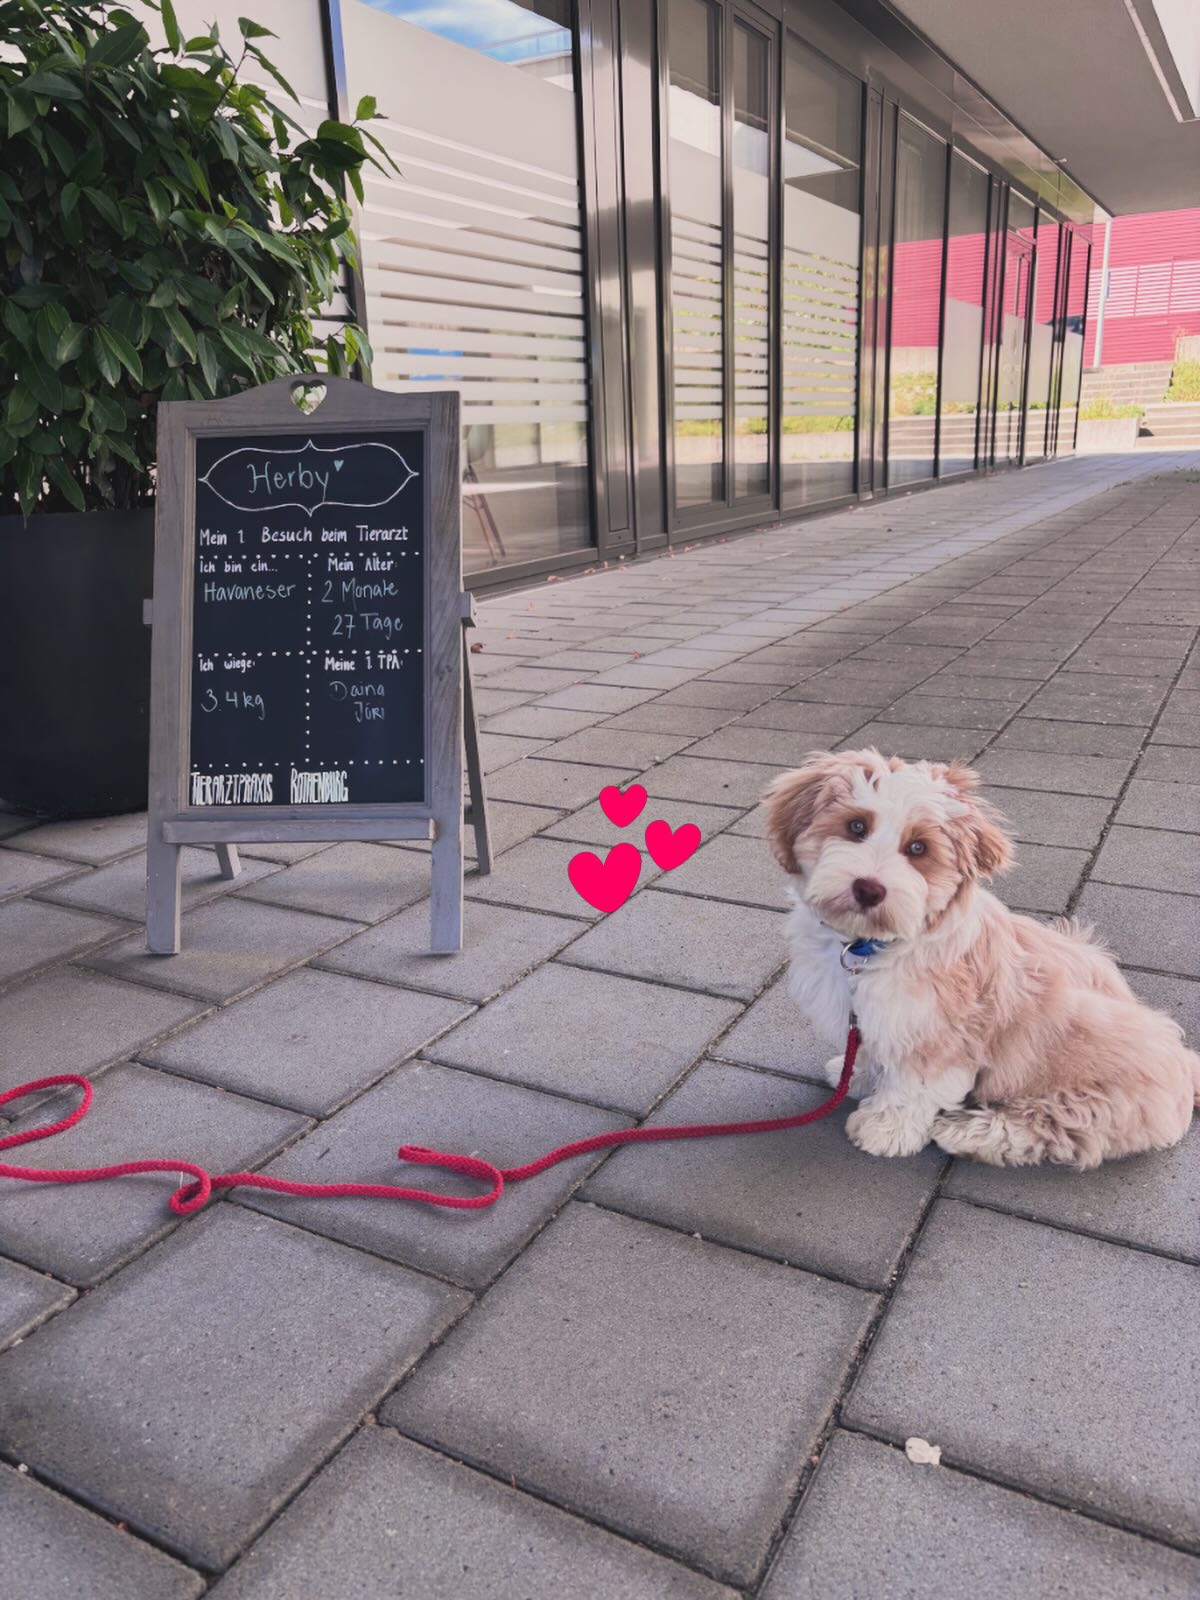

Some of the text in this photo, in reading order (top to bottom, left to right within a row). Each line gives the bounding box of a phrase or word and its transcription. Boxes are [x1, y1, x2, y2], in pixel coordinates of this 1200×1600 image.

[247, 461, 329, 503] Herby
[200, 528, 227, 546] Mein
[261, 526, 313, 543] Besuch
[321, 528, 347, 543] beim
[356, 524, 408, 542] Tierarzt
[199, 560, 216, 573] Ich
[224, 560, 242, 573] bin
[327, 557, 354, 572] Mein
[204, 581, 297, 603] Havaneser
[321, 576, 399, 612] 2 Monate
[332, 611, 403, 641] 27 Tage
[199, 658, 214, 672] Ich
[324, 656, 356, 671] Meine
[290, 767, 349, 804] ROTHENBURG
